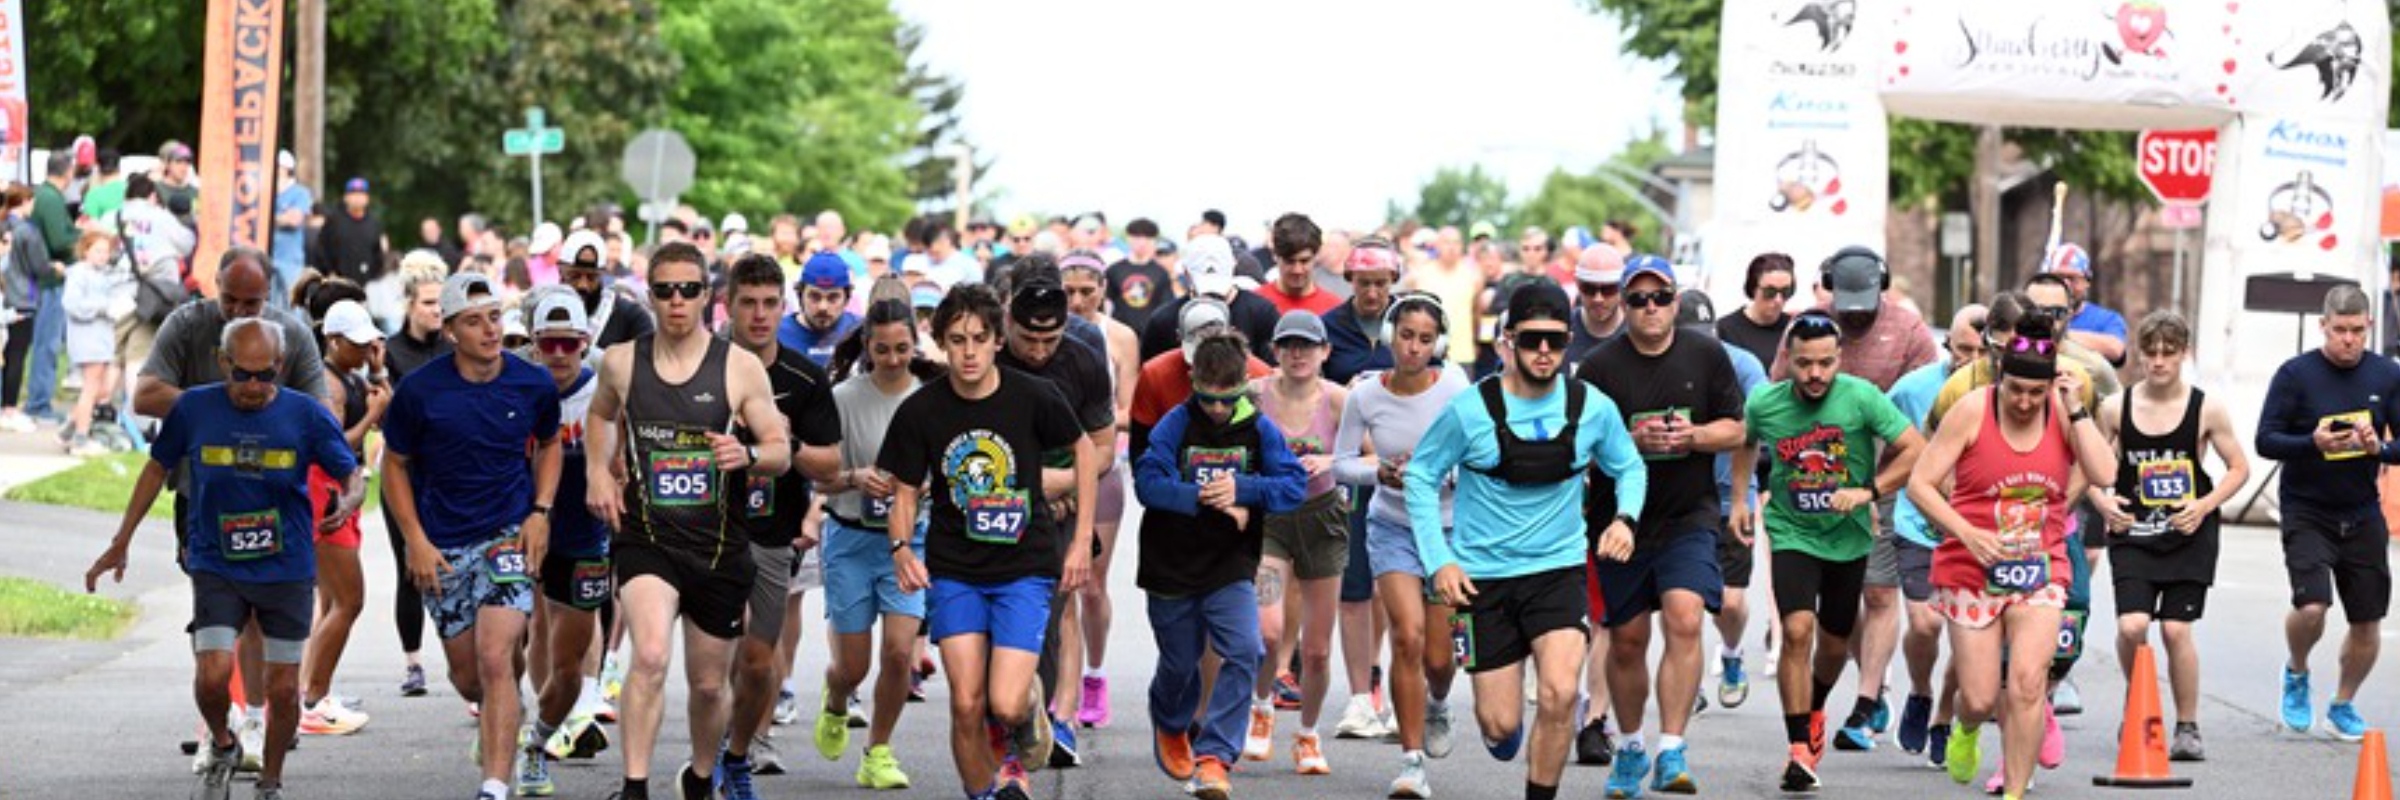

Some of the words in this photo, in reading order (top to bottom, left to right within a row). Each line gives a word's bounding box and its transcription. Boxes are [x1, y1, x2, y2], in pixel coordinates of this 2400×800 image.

[2145, 138, 2217, 176] STOP
[658, 472, 708, 495] 505
[2151, 477, 2185, 497] 133
[976, 511, 1023, 533] 547
[231, 529, 273, 550] 522
[1994, 565, 2040, 586] 507
